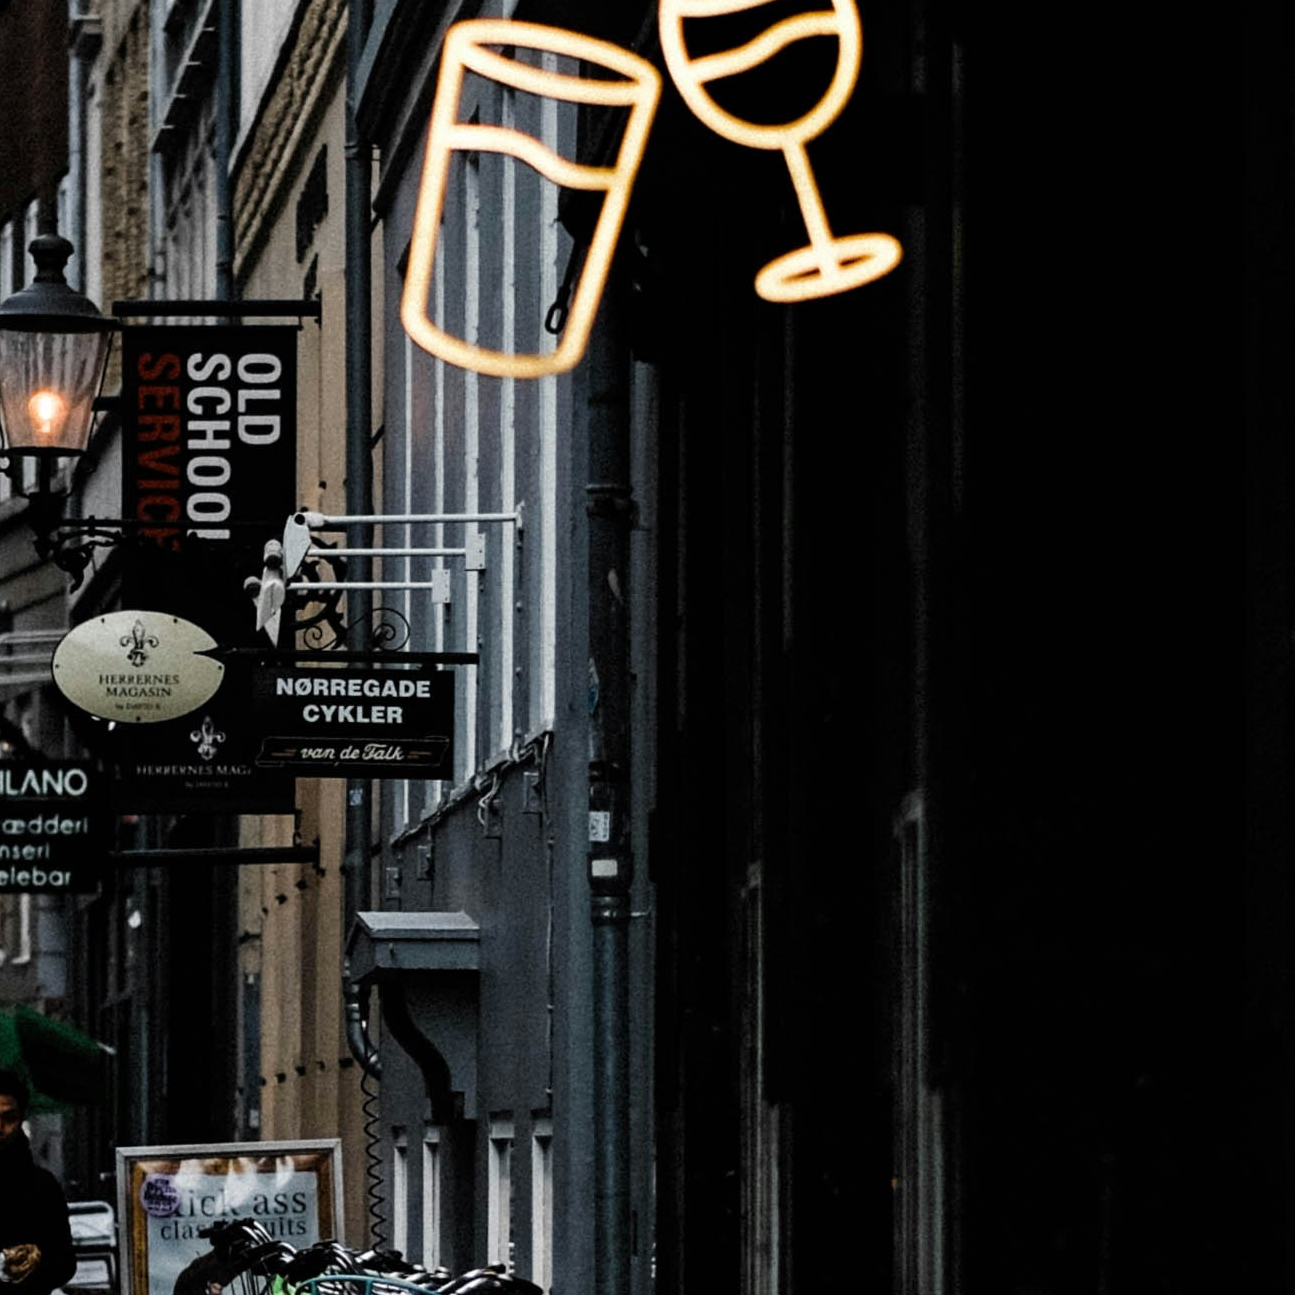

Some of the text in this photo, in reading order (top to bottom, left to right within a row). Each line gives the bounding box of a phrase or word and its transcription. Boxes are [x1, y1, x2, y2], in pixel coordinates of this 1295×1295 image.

[236, 352, 283, 446] OLD
[99, 674, 181, 685] HERRERNES
[276, 677, 431, 698] NØRREGADE
[106, 687, 172, 698] MAGASIN
[302, 705, 403, 723] CYKLER
[300, 748, 336, 759] van
[339, 745, 360, 759] de
[253, 1192, 307, 1215] ass
